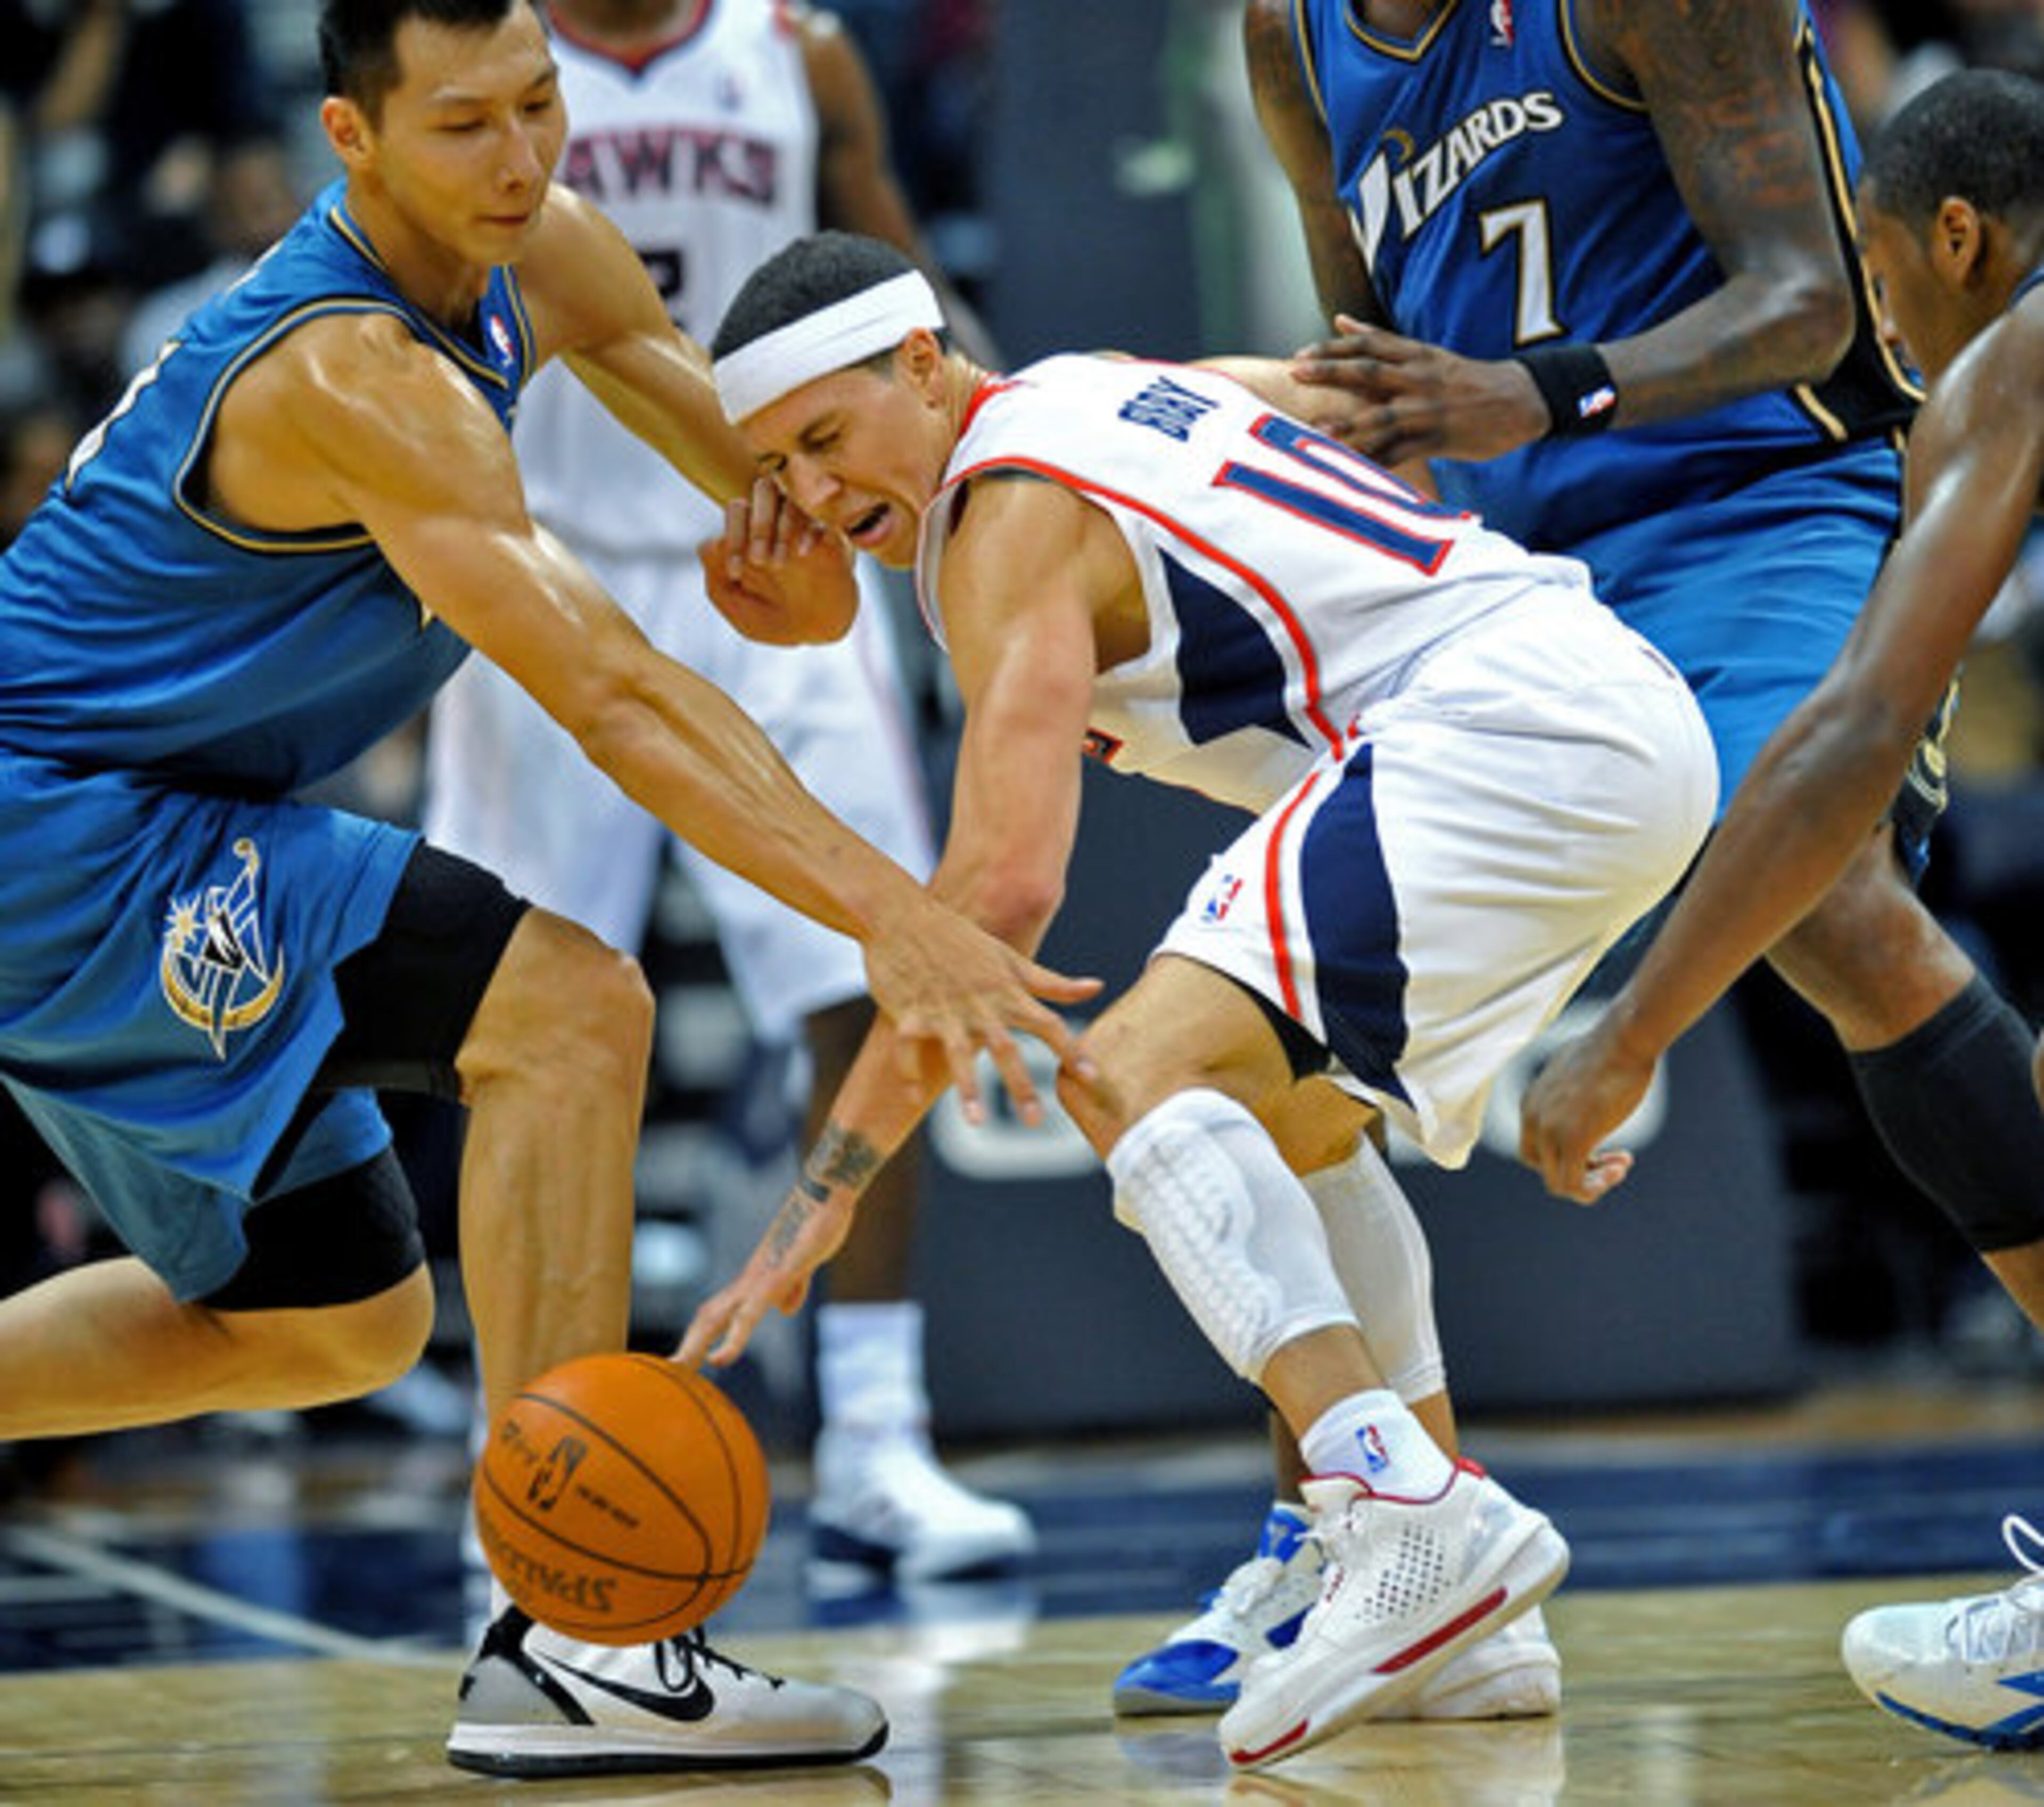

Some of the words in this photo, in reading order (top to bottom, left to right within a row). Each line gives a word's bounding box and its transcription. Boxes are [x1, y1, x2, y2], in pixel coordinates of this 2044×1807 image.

[563, 128, 777, 207] AWKS
[1478, 197, 1564, 347] 7
[1211, 412, 1472, 576] 10
